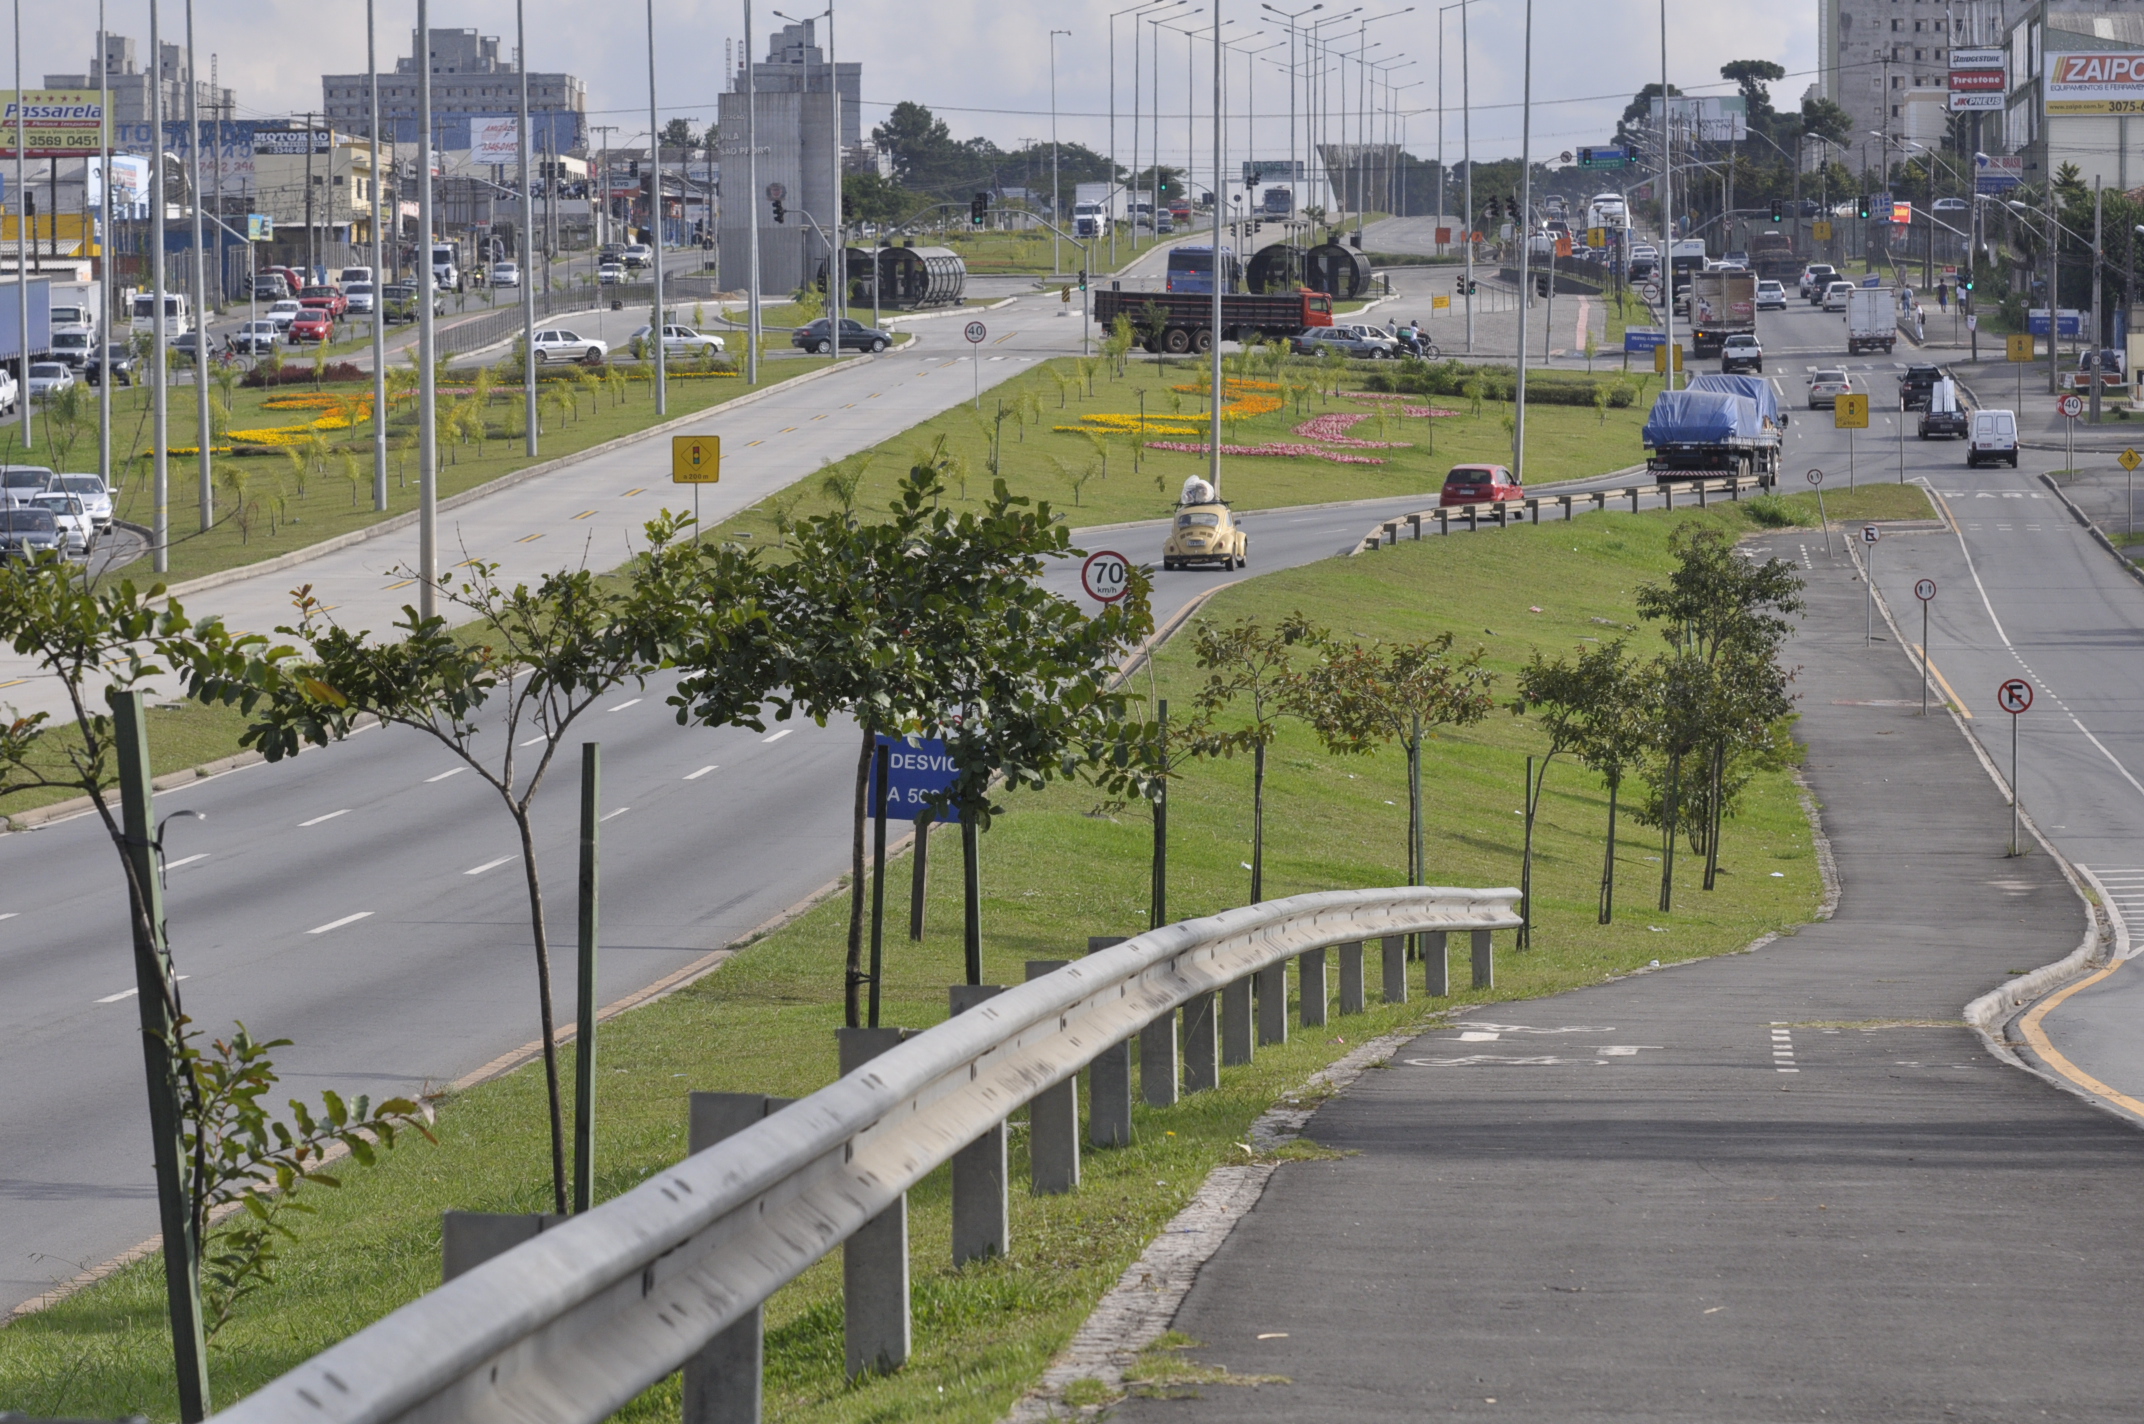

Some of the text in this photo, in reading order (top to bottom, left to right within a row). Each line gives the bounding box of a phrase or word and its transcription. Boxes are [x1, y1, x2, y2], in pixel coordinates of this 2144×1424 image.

[1952, 76, 2000, 85] Firestone
[2050, 84, 2104, 92] EQUIPAMENTOS
[29, 136, 62, 146] 3569
[66, 136, 98, 146] 0451
[720, 132, 740, 140] VILA
[720, 146, 737, 155] SÃO
[968, 325, 983, 336] 40
[2065, 398, 2079, 409] 40
[1093, 562, 1123, 584] 70
[887, 786, 900, 802] A
